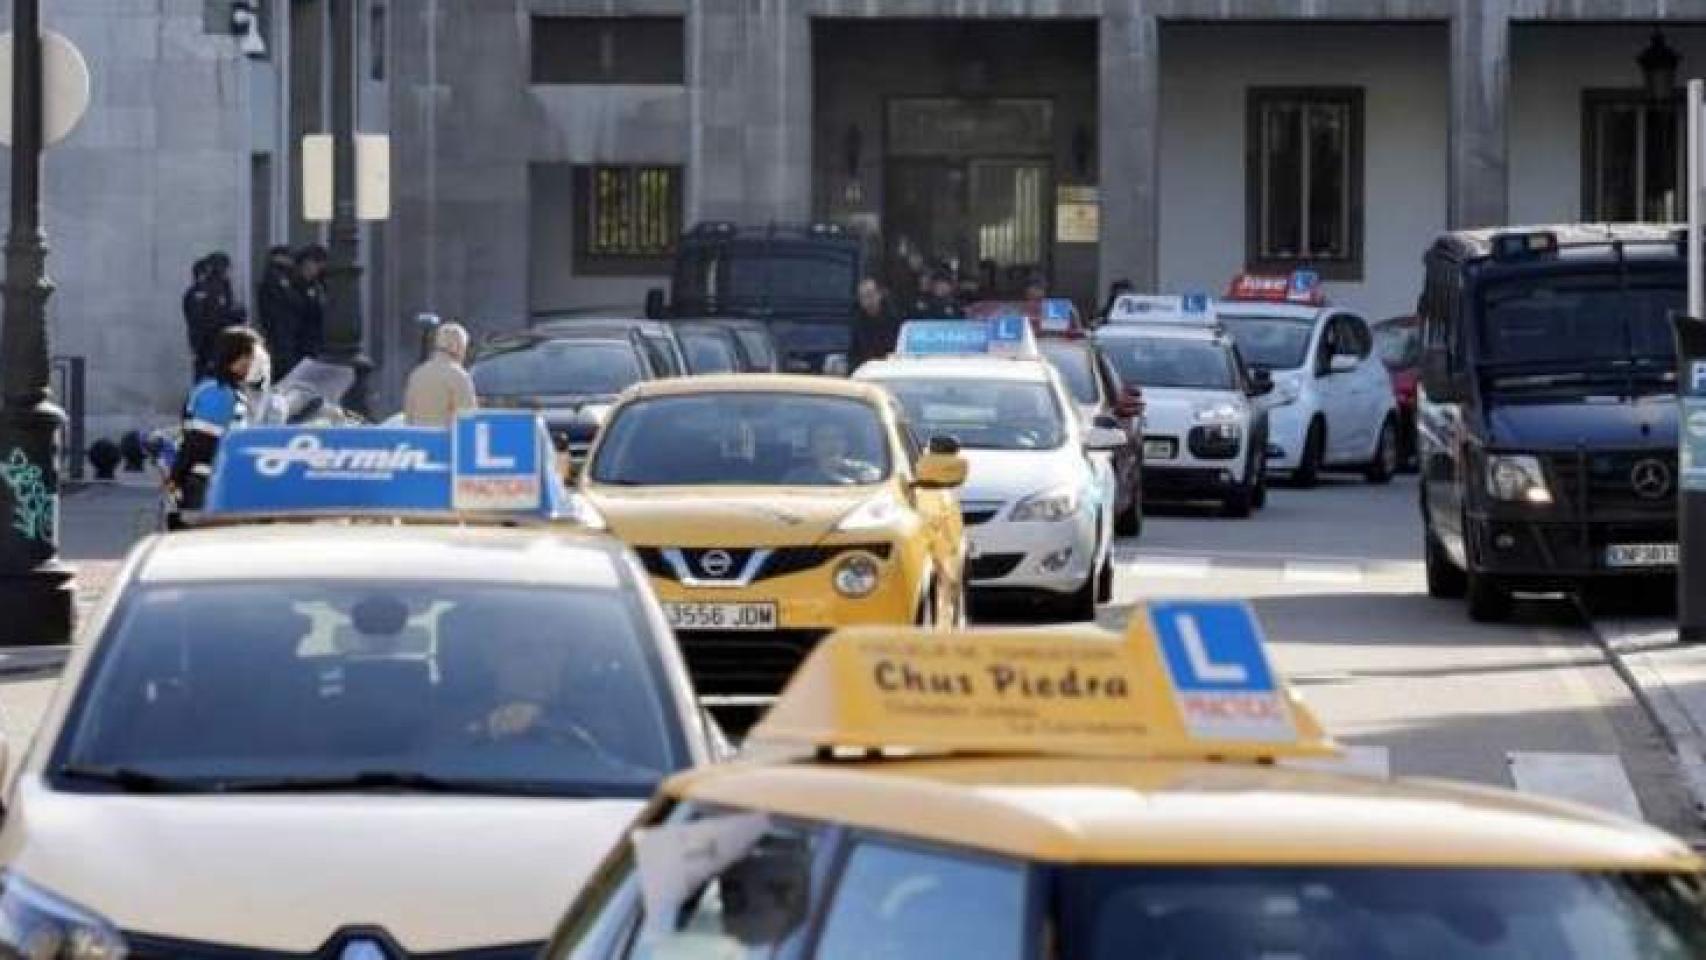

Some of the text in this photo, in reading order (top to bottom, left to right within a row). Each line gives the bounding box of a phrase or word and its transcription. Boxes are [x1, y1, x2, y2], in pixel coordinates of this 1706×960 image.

[999, 319, 1017, 339] L
[475, 423, 515, 468] L
[1176, 614, 1248, 681] L
[873, 659, 1129, 698] Chus Piedra
